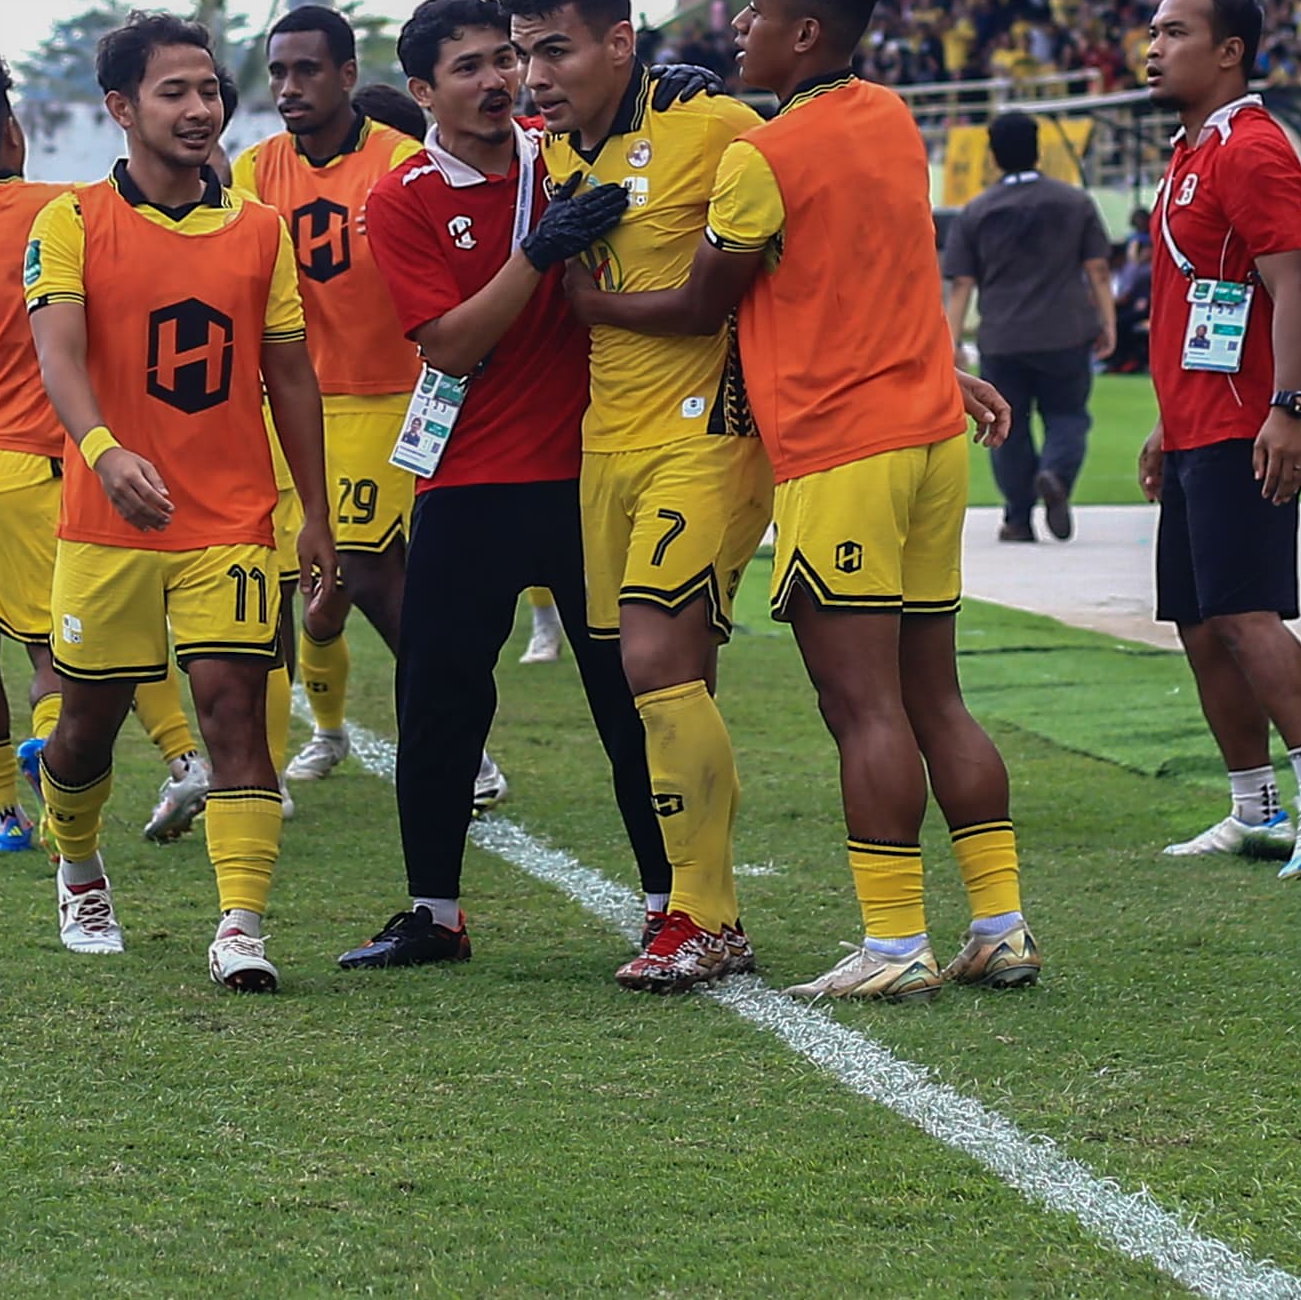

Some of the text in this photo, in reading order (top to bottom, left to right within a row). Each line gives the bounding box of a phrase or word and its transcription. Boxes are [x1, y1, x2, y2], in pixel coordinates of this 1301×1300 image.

[337, 478, 378, 524] 29
[651, 509, 686, 566] 7
[228, 564, 267, 624] 11
